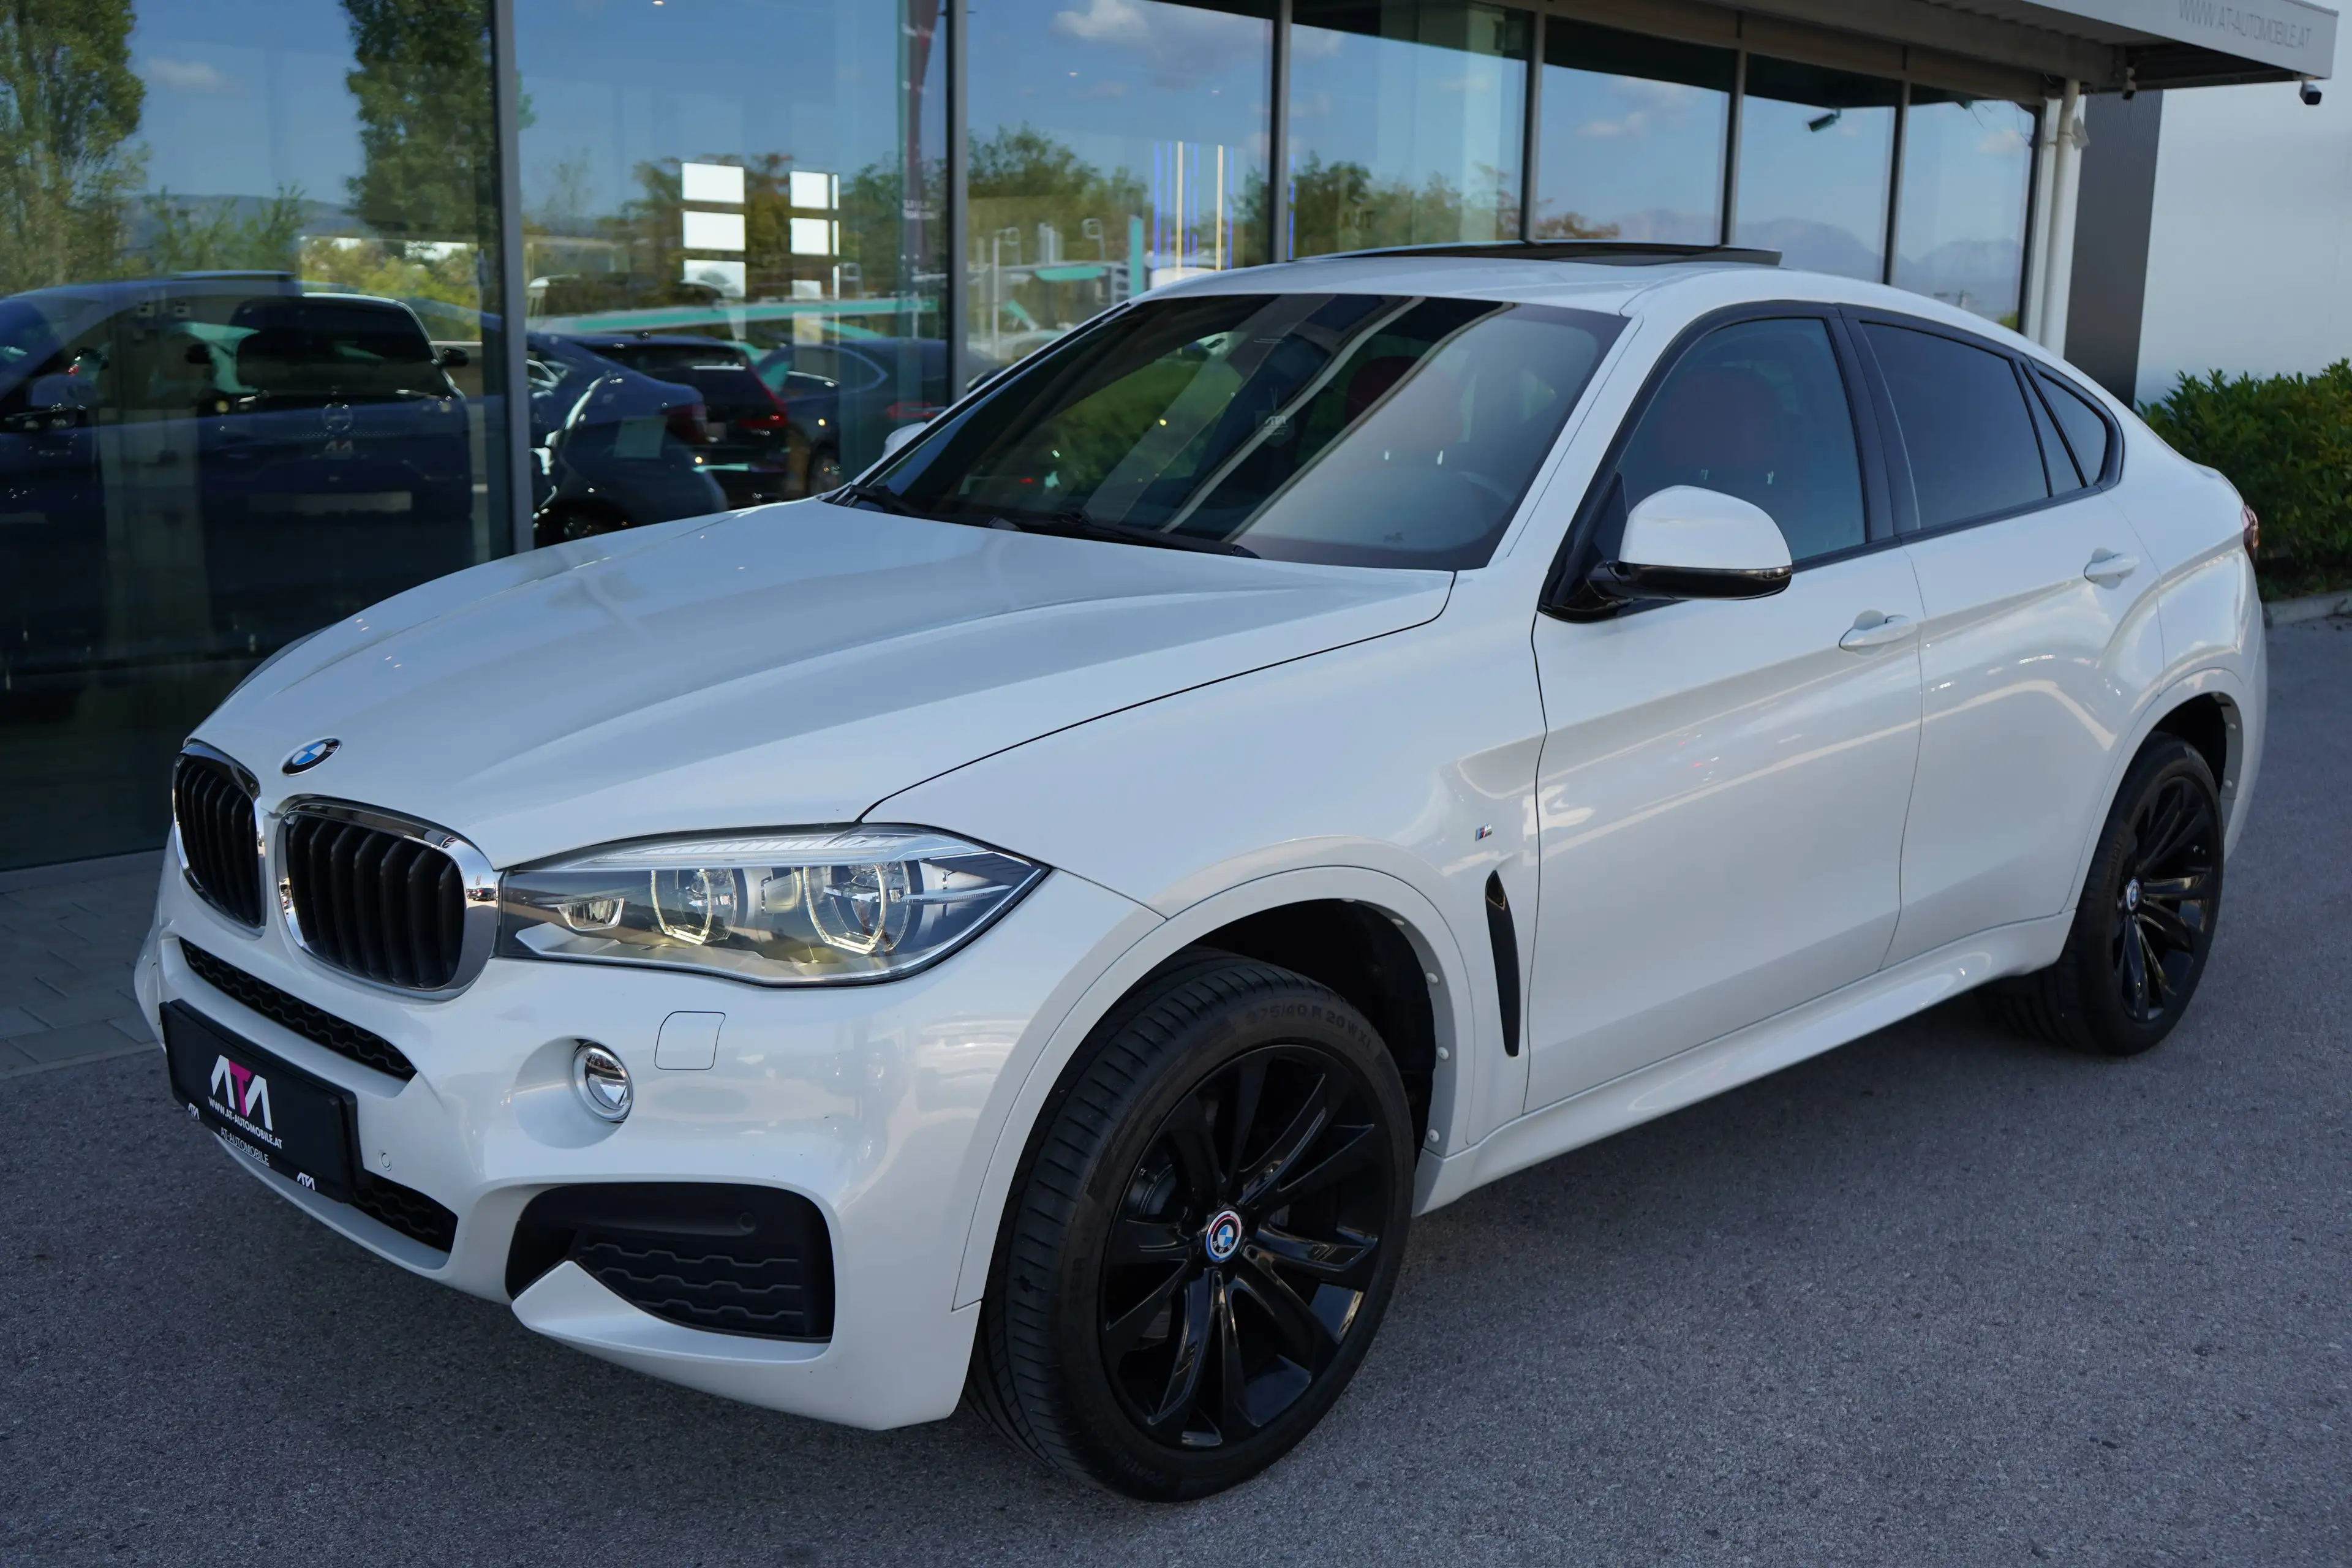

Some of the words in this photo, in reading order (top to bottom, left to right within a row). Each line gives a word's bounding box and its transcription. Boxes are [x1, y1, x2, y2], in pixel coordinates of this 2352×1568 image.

[1325, 1010, 1346, 1029] 20
[208, 1096, 282, 1150] WWW.AT-AUTOMOBILE.AT
[221, 1126, 270, 1165] AT-AUTOMOBILE
